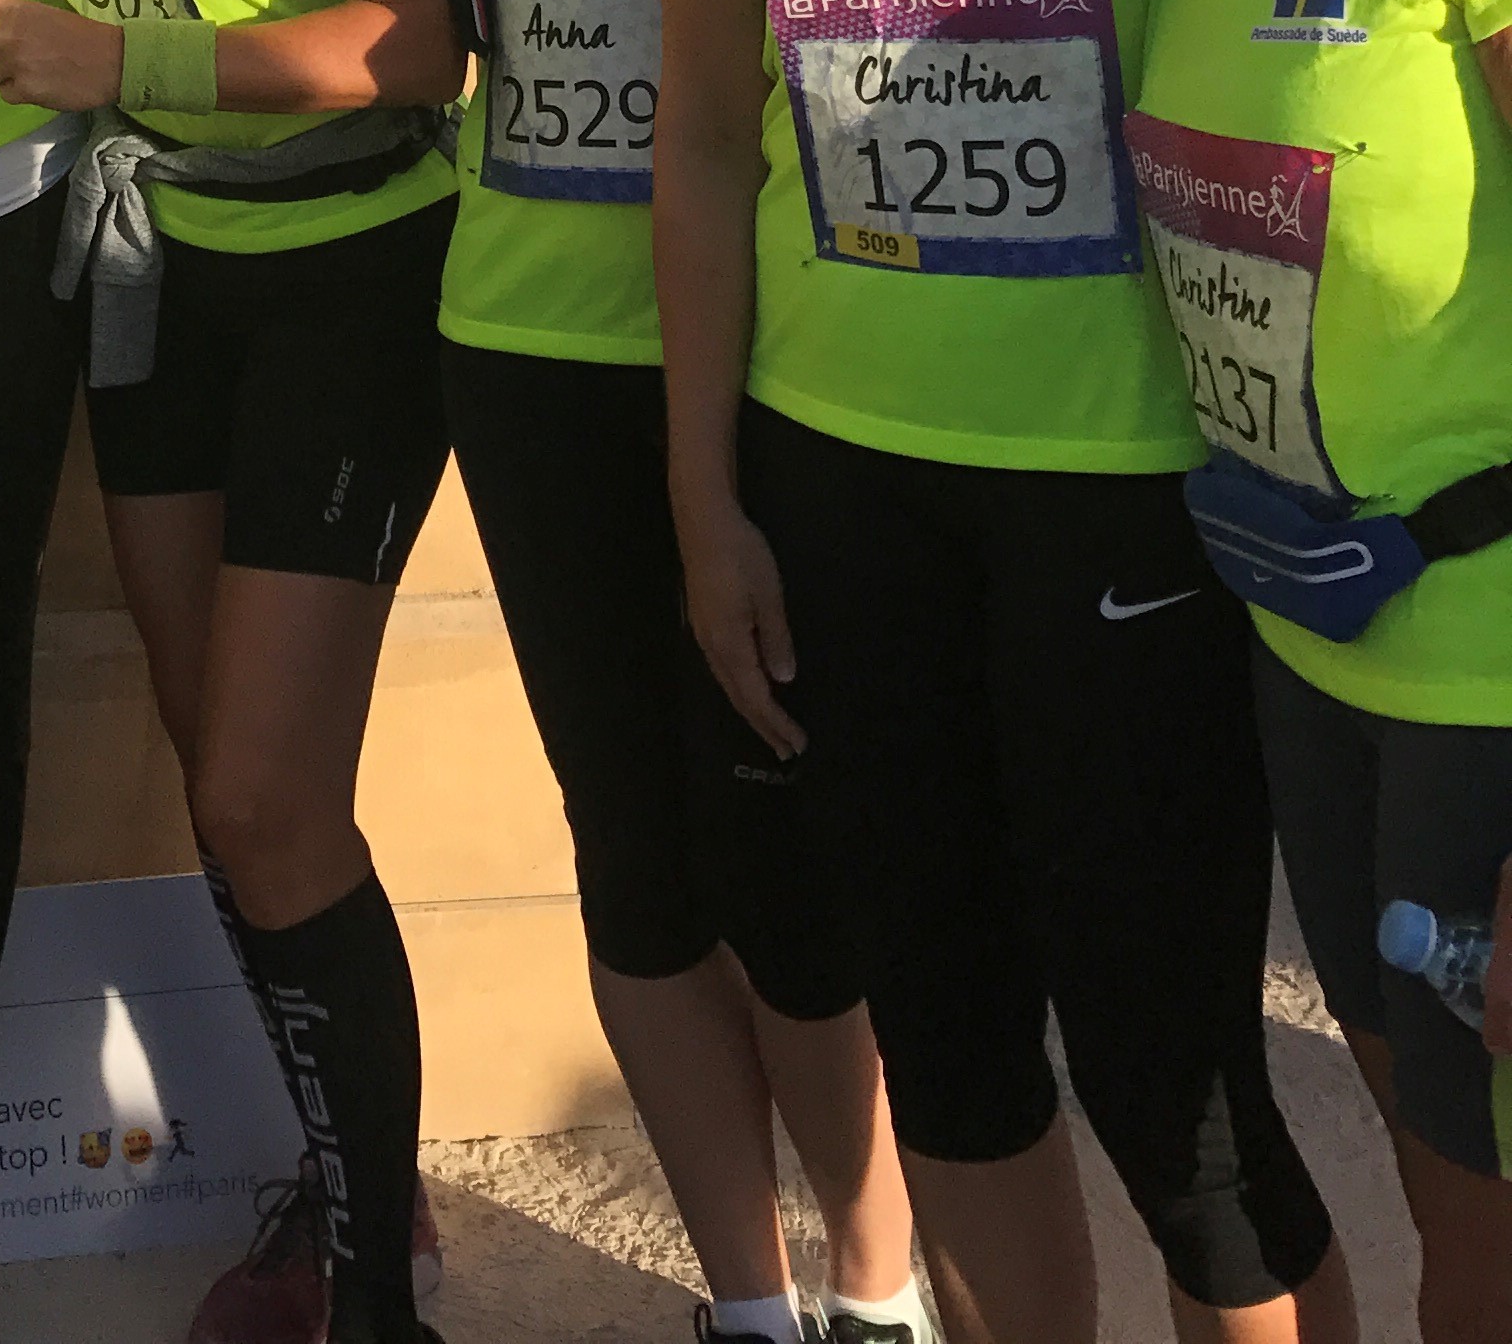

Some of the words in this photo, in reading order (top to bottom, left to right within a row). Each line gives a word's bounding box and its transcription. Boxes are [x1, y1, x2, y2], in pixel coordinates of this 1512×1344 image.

[522, 2, 616, 52] Anna
[1251, 26, 1306, 42] Ambassade
[1309, 27, 1324, 42] de
[1327, 26, 1368, 43] Suède
[853, 54, 1052, 105] Christina
[501, 75, 658, 149] 2529
[855, 138, 1067, 218] 1259
[856, 229, 901, 257] 509
[1168, 244, 1274, 332] Christine
[1179, 330, 1280, 454] 2137
